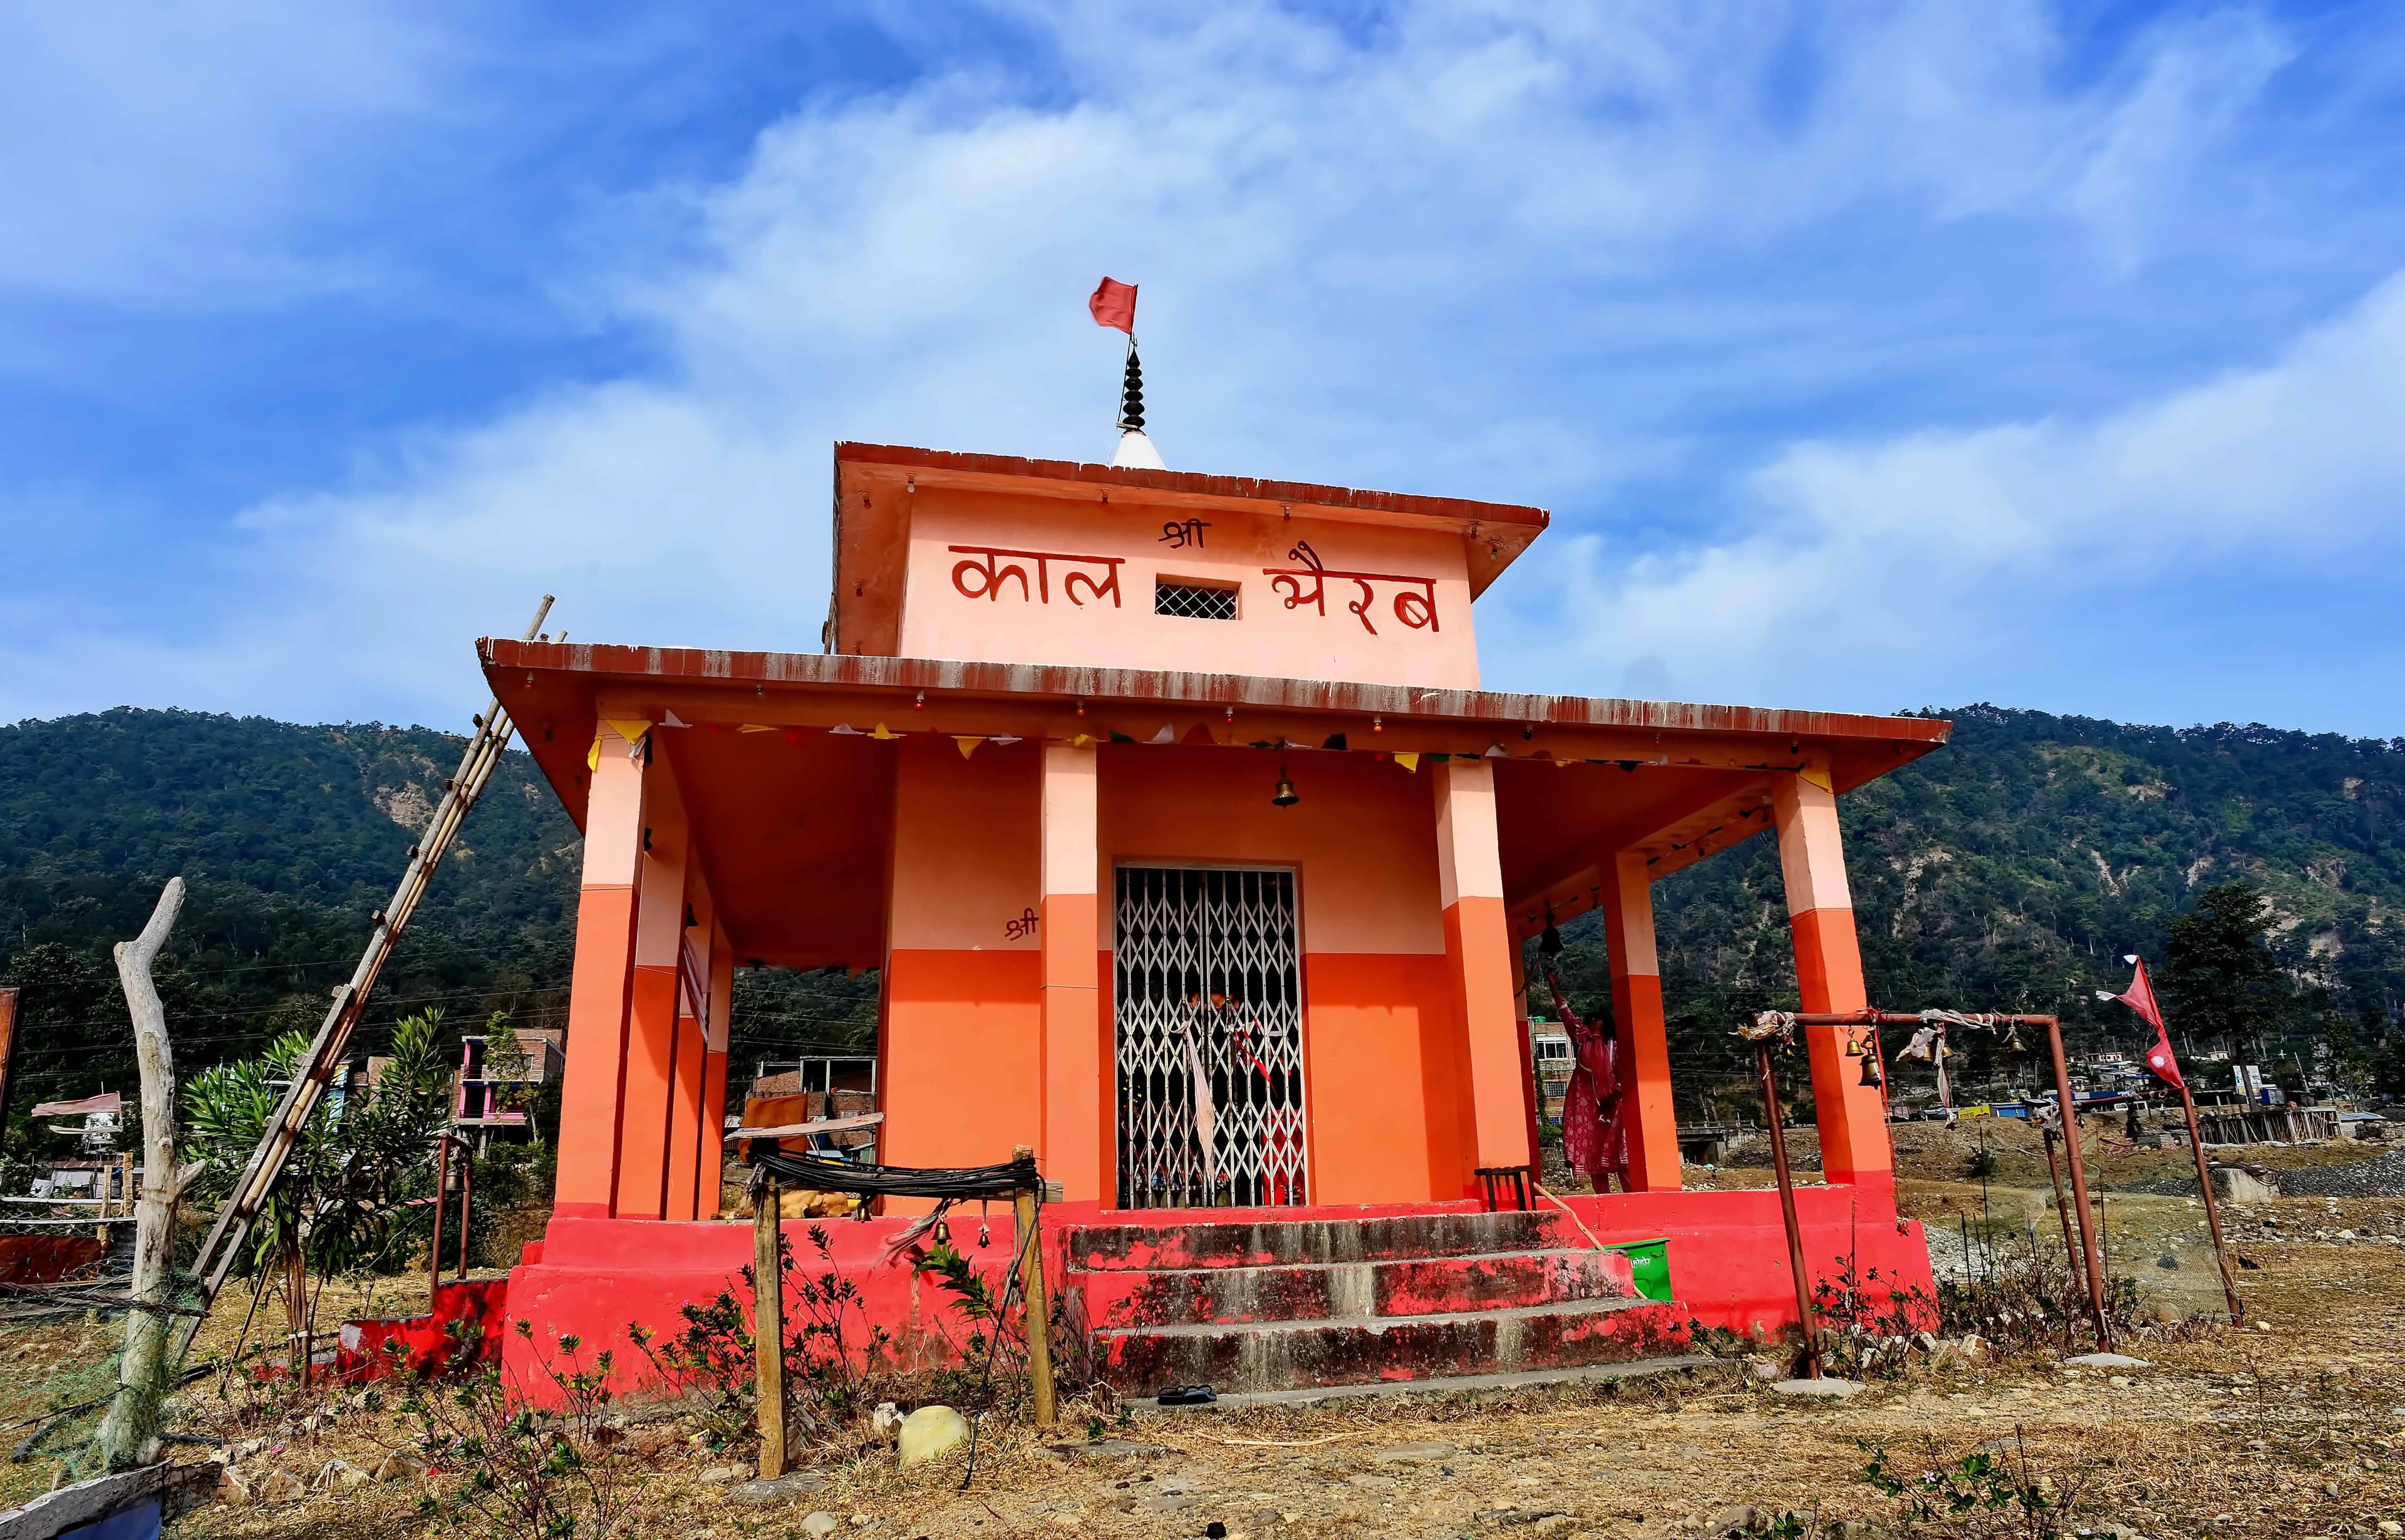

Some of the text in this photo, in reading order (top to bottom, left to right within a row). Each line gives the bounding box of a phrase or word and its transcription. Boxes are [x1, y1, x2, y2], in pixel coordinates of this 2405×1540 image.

[1157, 517, 1213, 549] श्री
[948, 545, 1126, 609] काल
[1004, 907, 1040, 941] श्री
